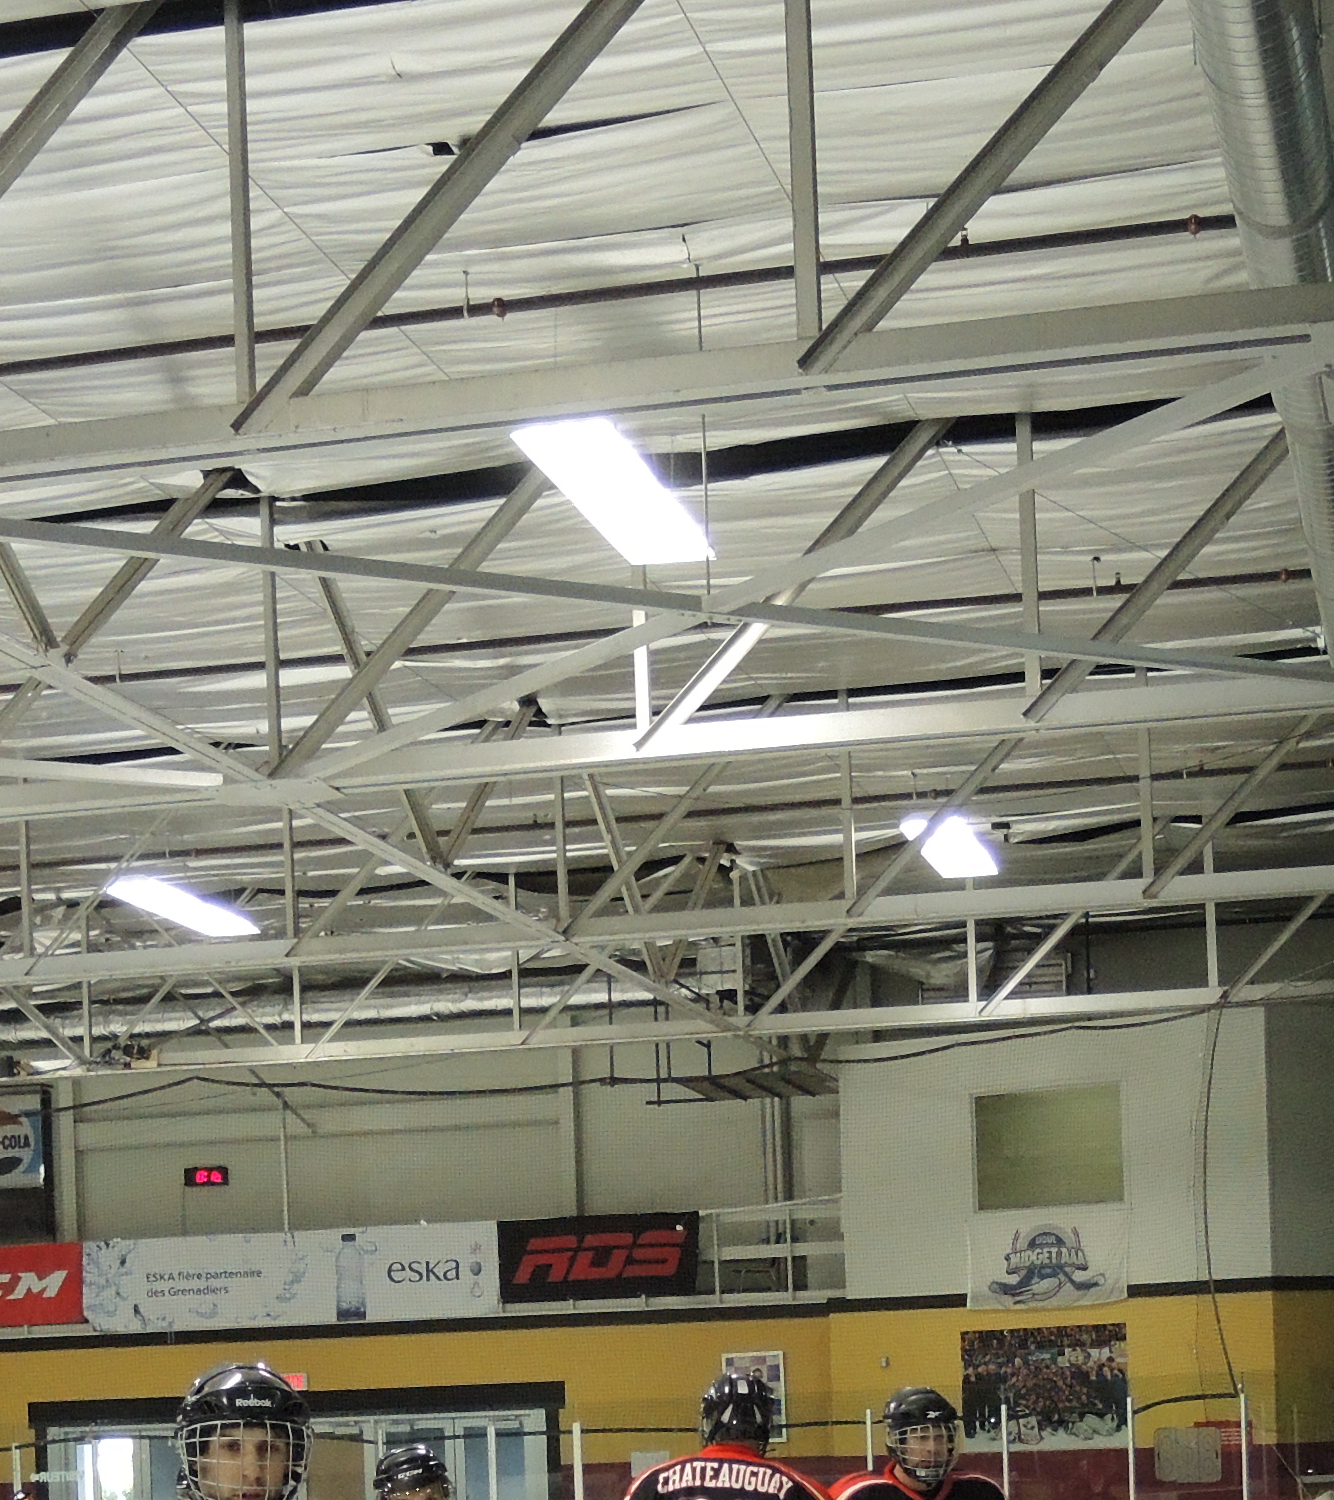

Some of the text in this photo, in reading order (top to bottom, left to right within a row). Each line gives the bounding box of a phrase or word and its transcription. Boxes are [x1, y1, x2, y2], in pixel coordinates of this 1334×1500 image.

[146, 1269, 263, 1282] ESKA fière partenaire
[387, 1259, 460, 1283] eska
[147, 1285, 229, 1297] des Grenadiers
[236, 1394, 271, 1407] Reebok
[657, 1461, 793, 1500] CHATEAUGUAY
